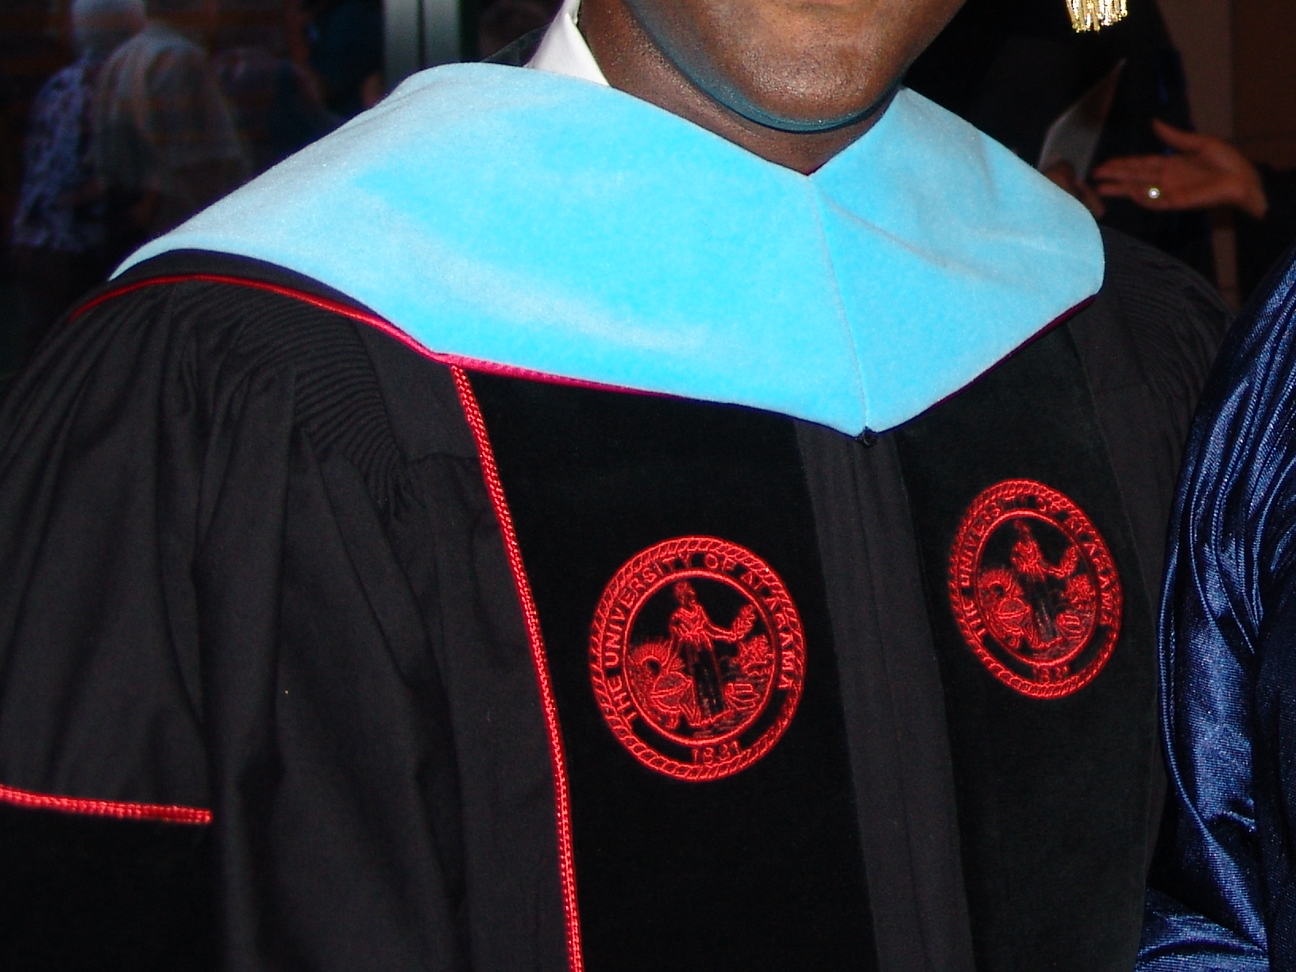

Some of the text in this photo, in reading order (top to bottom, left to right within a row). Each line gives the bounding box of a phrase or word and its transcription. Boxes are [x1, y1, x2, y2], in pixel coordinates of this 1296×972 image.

[604, 553, 796, 723] THE UNIVERSITY OF ALABAMA
